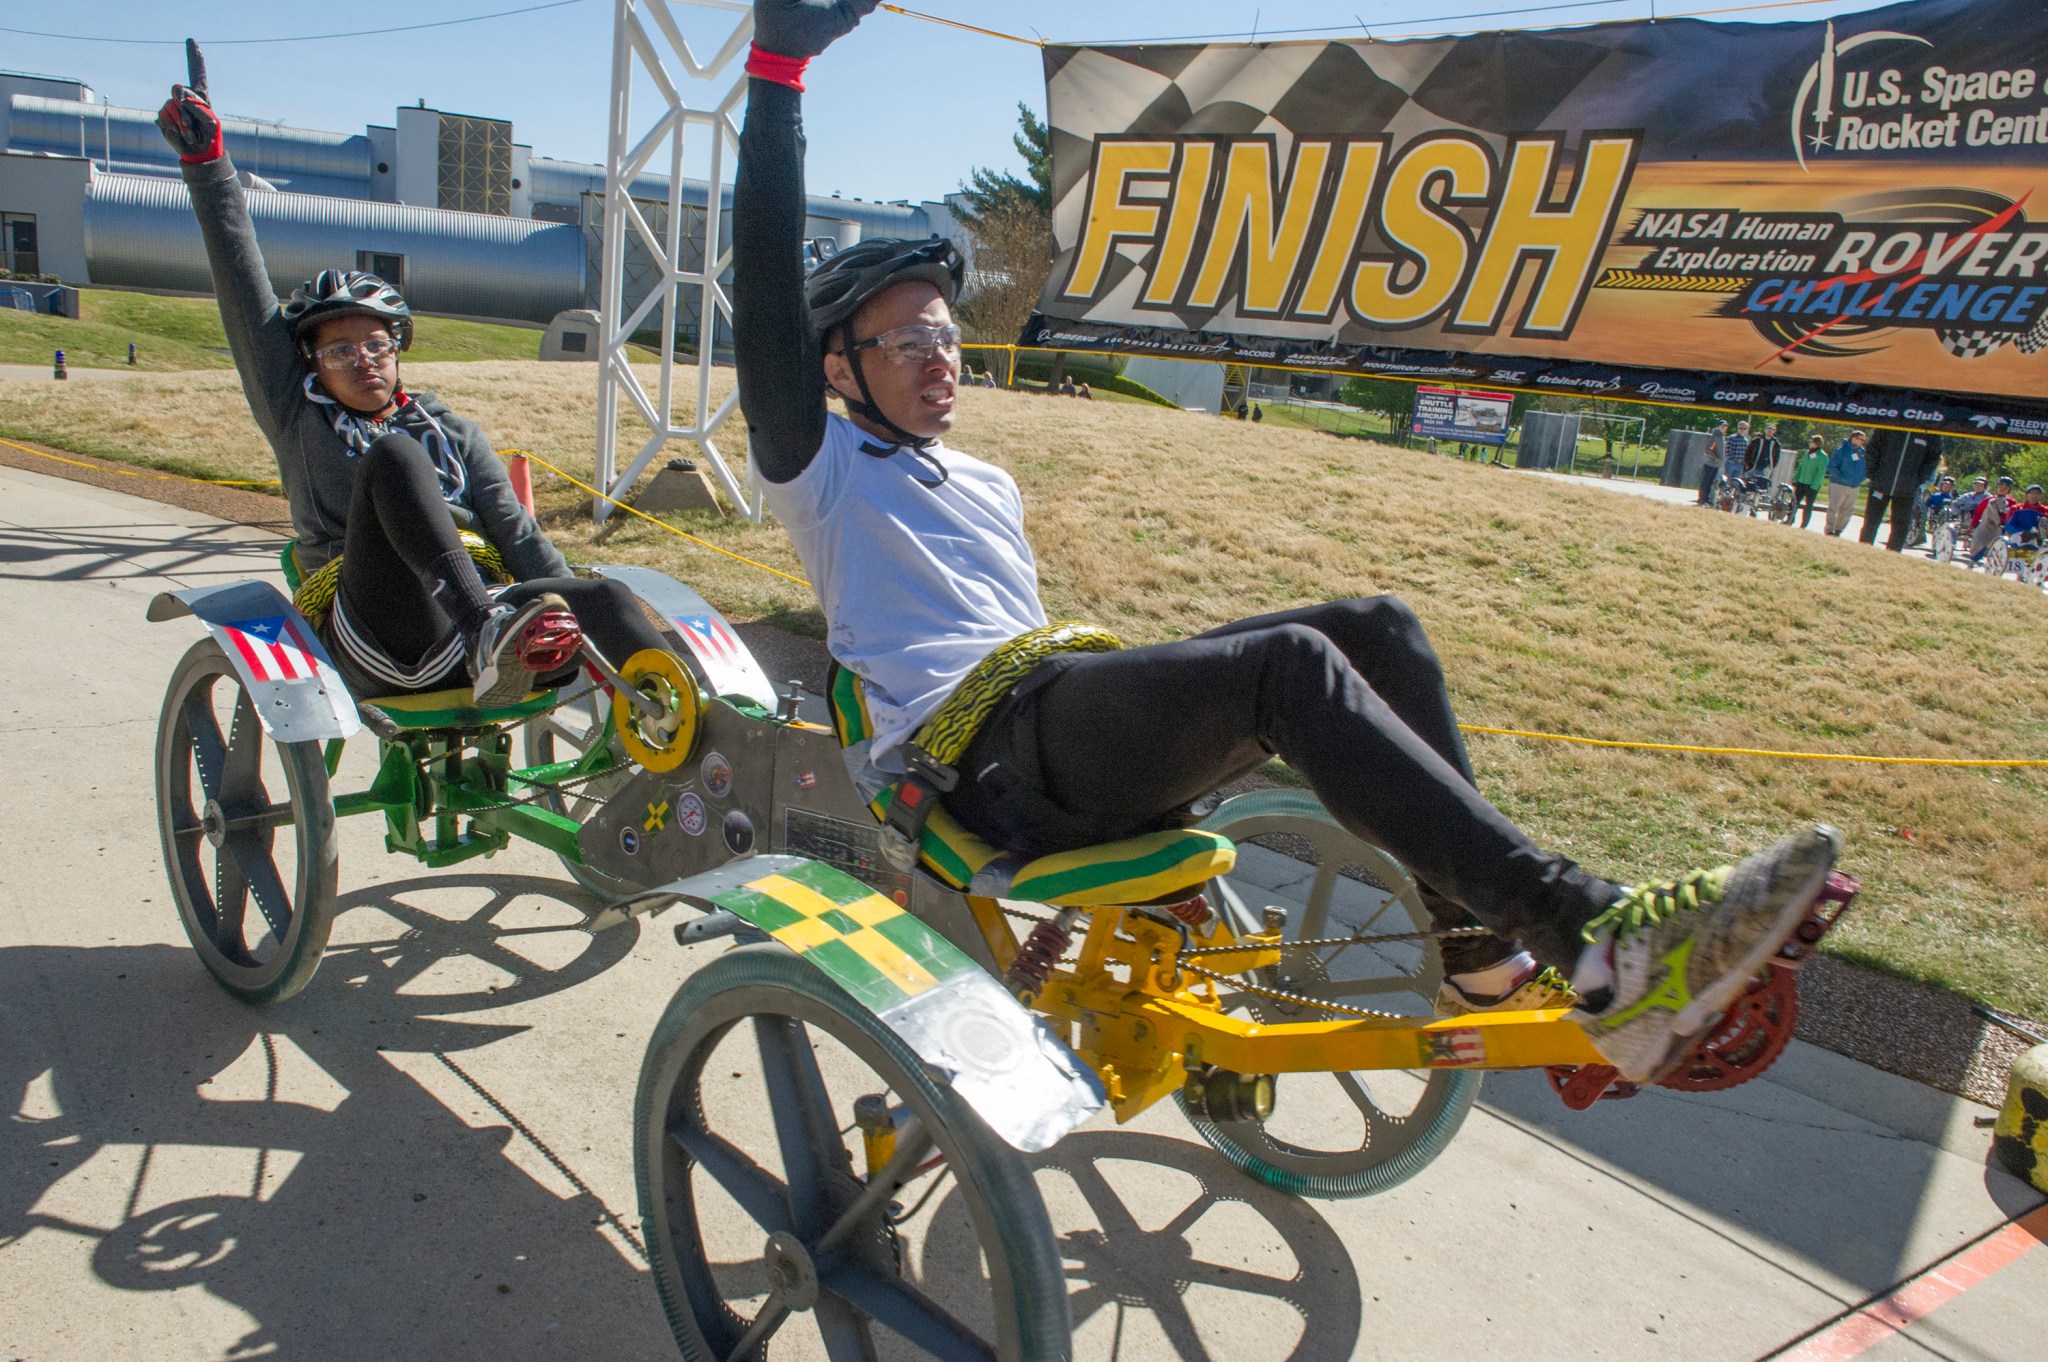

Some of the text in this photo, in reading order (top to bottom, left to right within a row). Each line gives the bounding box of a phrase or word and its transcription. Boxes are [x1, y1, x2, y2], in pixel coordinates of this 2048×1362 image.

[1842, 69, 1911, 108] U.S.
[1920, 66, 2036, 111] Space
[1835, 112, 1960, 150] Rocket
[1634, 213, 1835, 241] NASA Human
[1062, 137, 1635, 333] FINISH
[1654, 246, 1816, 275] Exploration
[1823, 231, 2048, 278] ROVER
[1746, 278, 2048, 323] CHALLENGE
[1053, 331, 1099, 343] BOEING
[1104, 336, 1208, 353] LOCKHEED MARTIN
[1234, 349, 1277, 359] JACOBS
[1362, 361, 1420, 372] NORTHROP
[1490, 369, 1526, 381] SAIC
[1536, 374, 1607, 389] Orbital ATK
[1713, 390, 1759, 401] COPT
[1417, 405, 1454, 415] TRAINING
[1420, 399, 1454, 408] SHUTTLE
[1772, 394, 1944, 421] National Space Club
[1416, 412, 1454, 421] AIRCRAFT
[2007, 426, 2041, 436] BROWN
